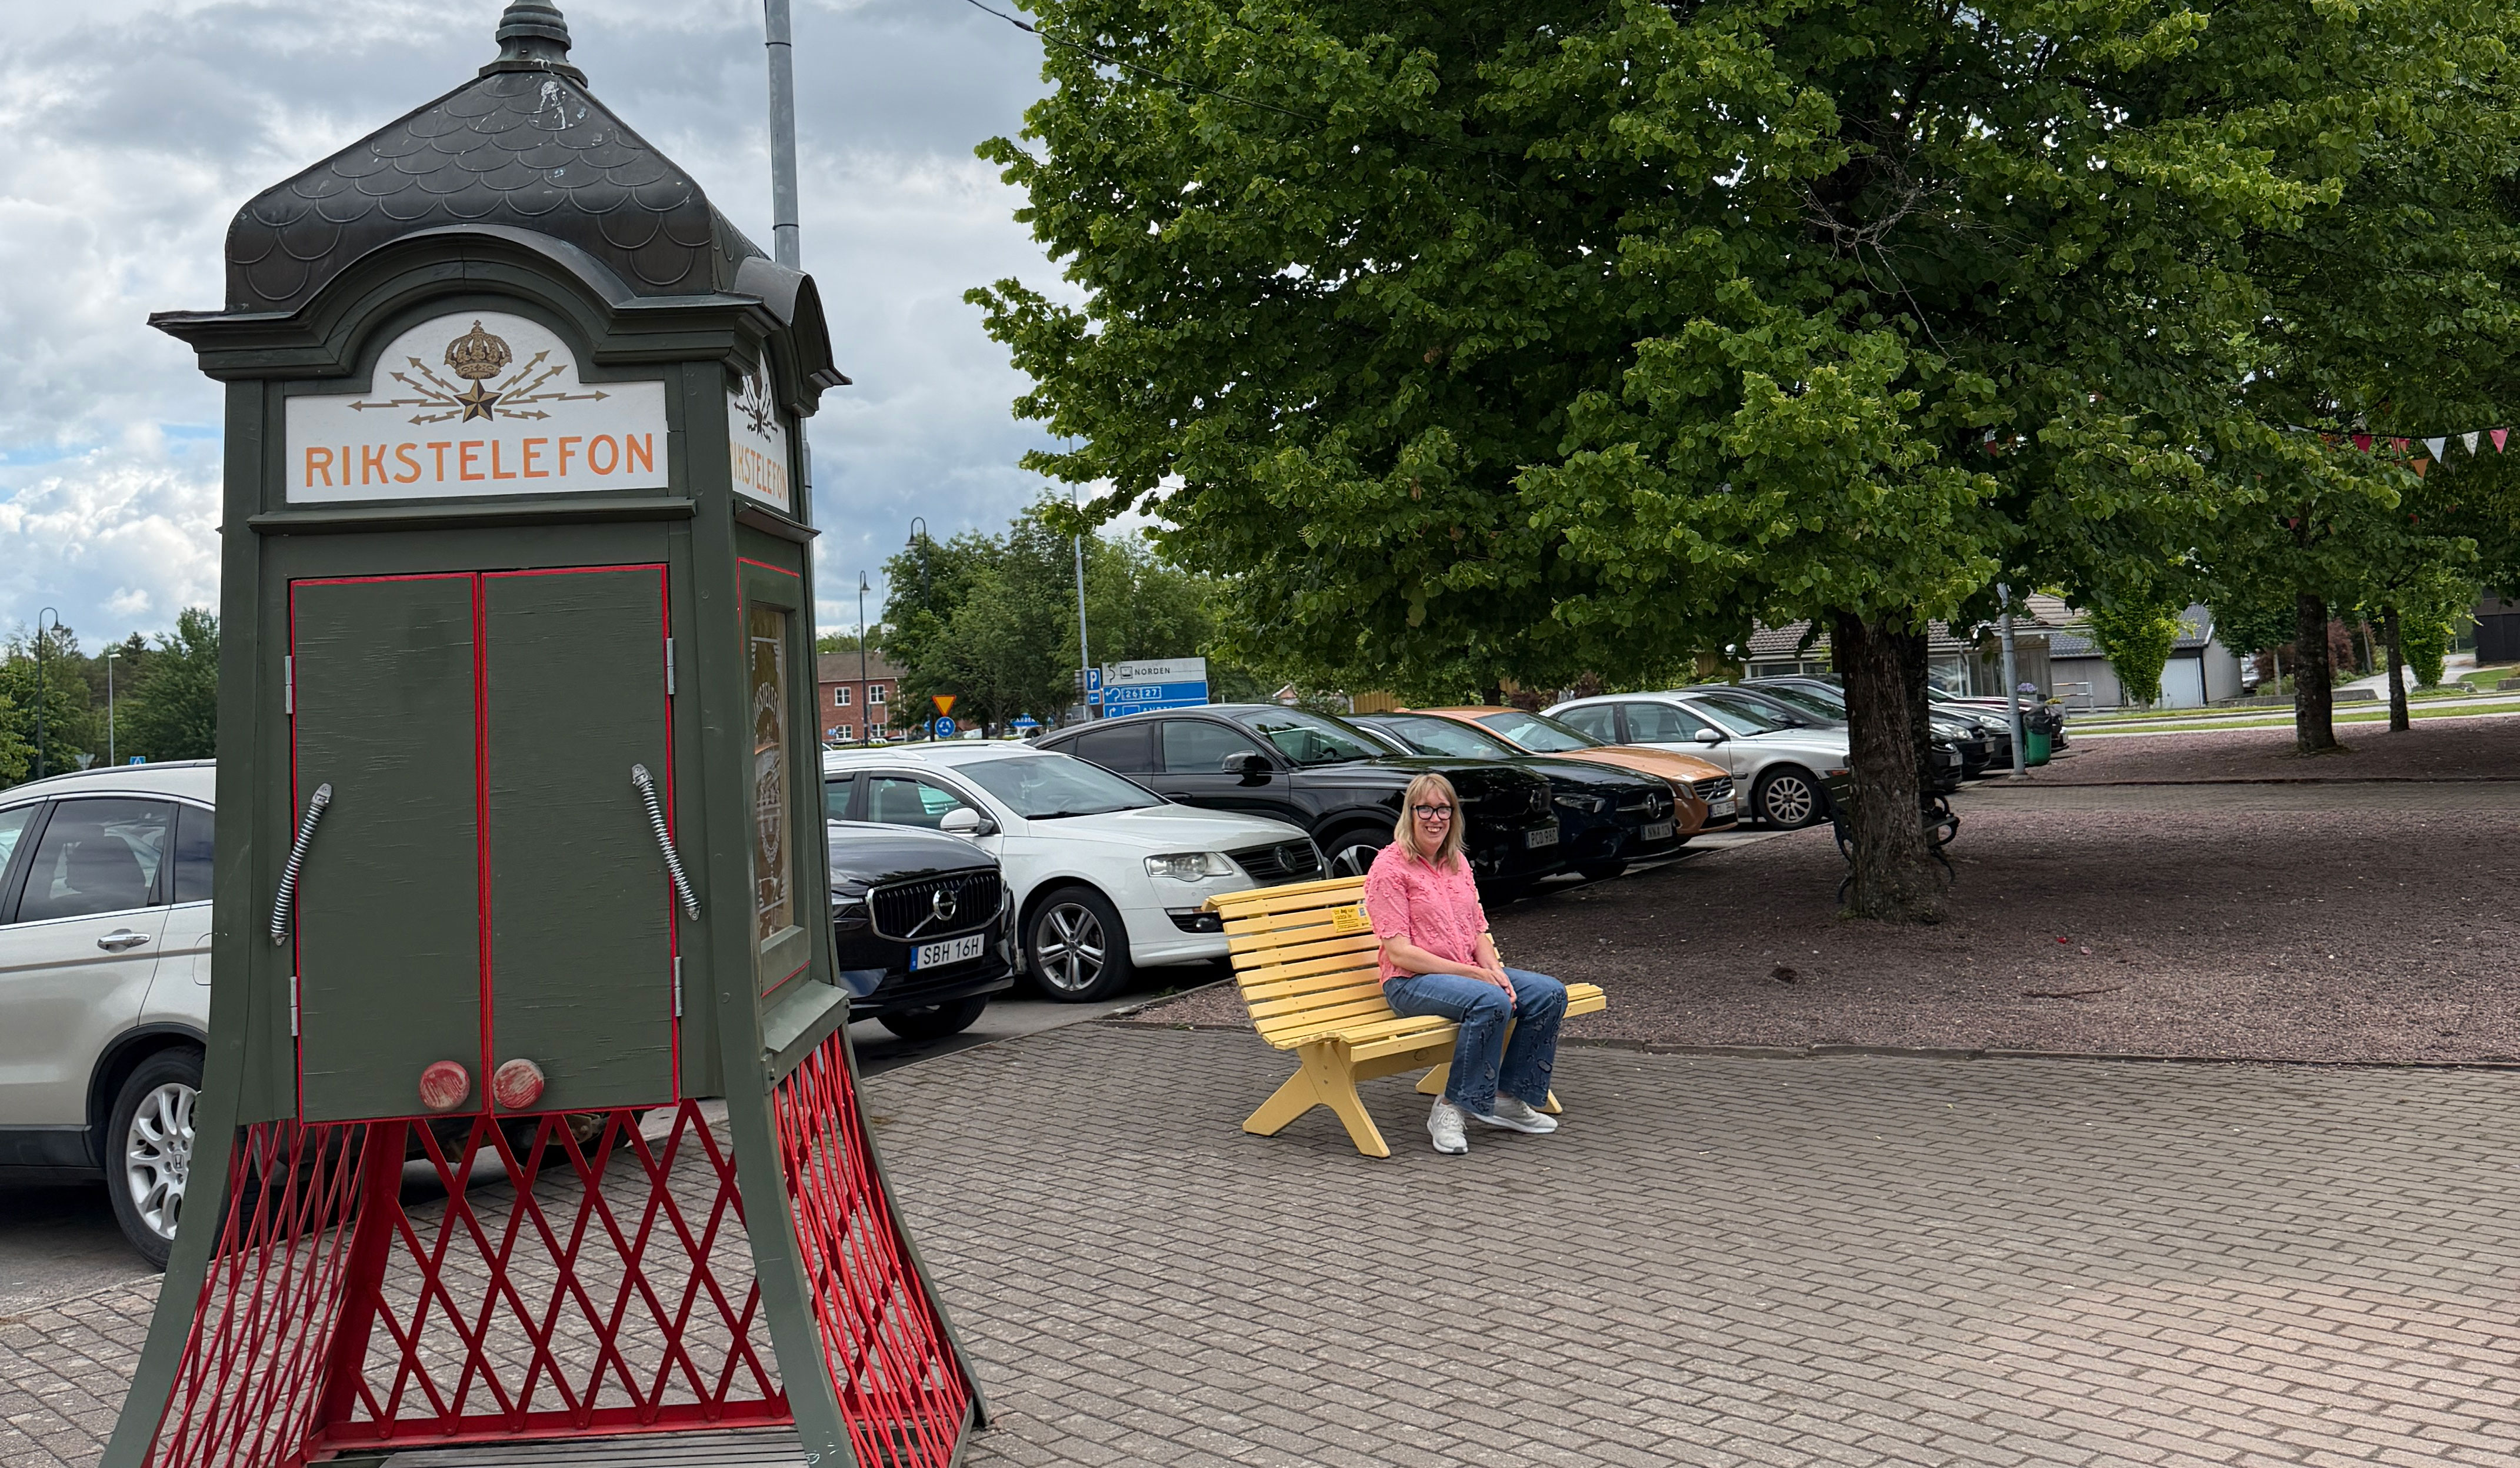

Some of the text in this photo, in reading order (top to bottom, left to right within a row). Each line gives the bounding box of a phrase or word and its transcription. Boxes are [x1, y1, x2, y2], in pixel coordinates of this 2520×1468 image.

[306, 433, 653, 487] RIKSTELEFON
[1090, 671, 1097, 689] P
[1135, 668, 1170, 676] NORDEN
[924, 937, 979, 965] SBH 16H
